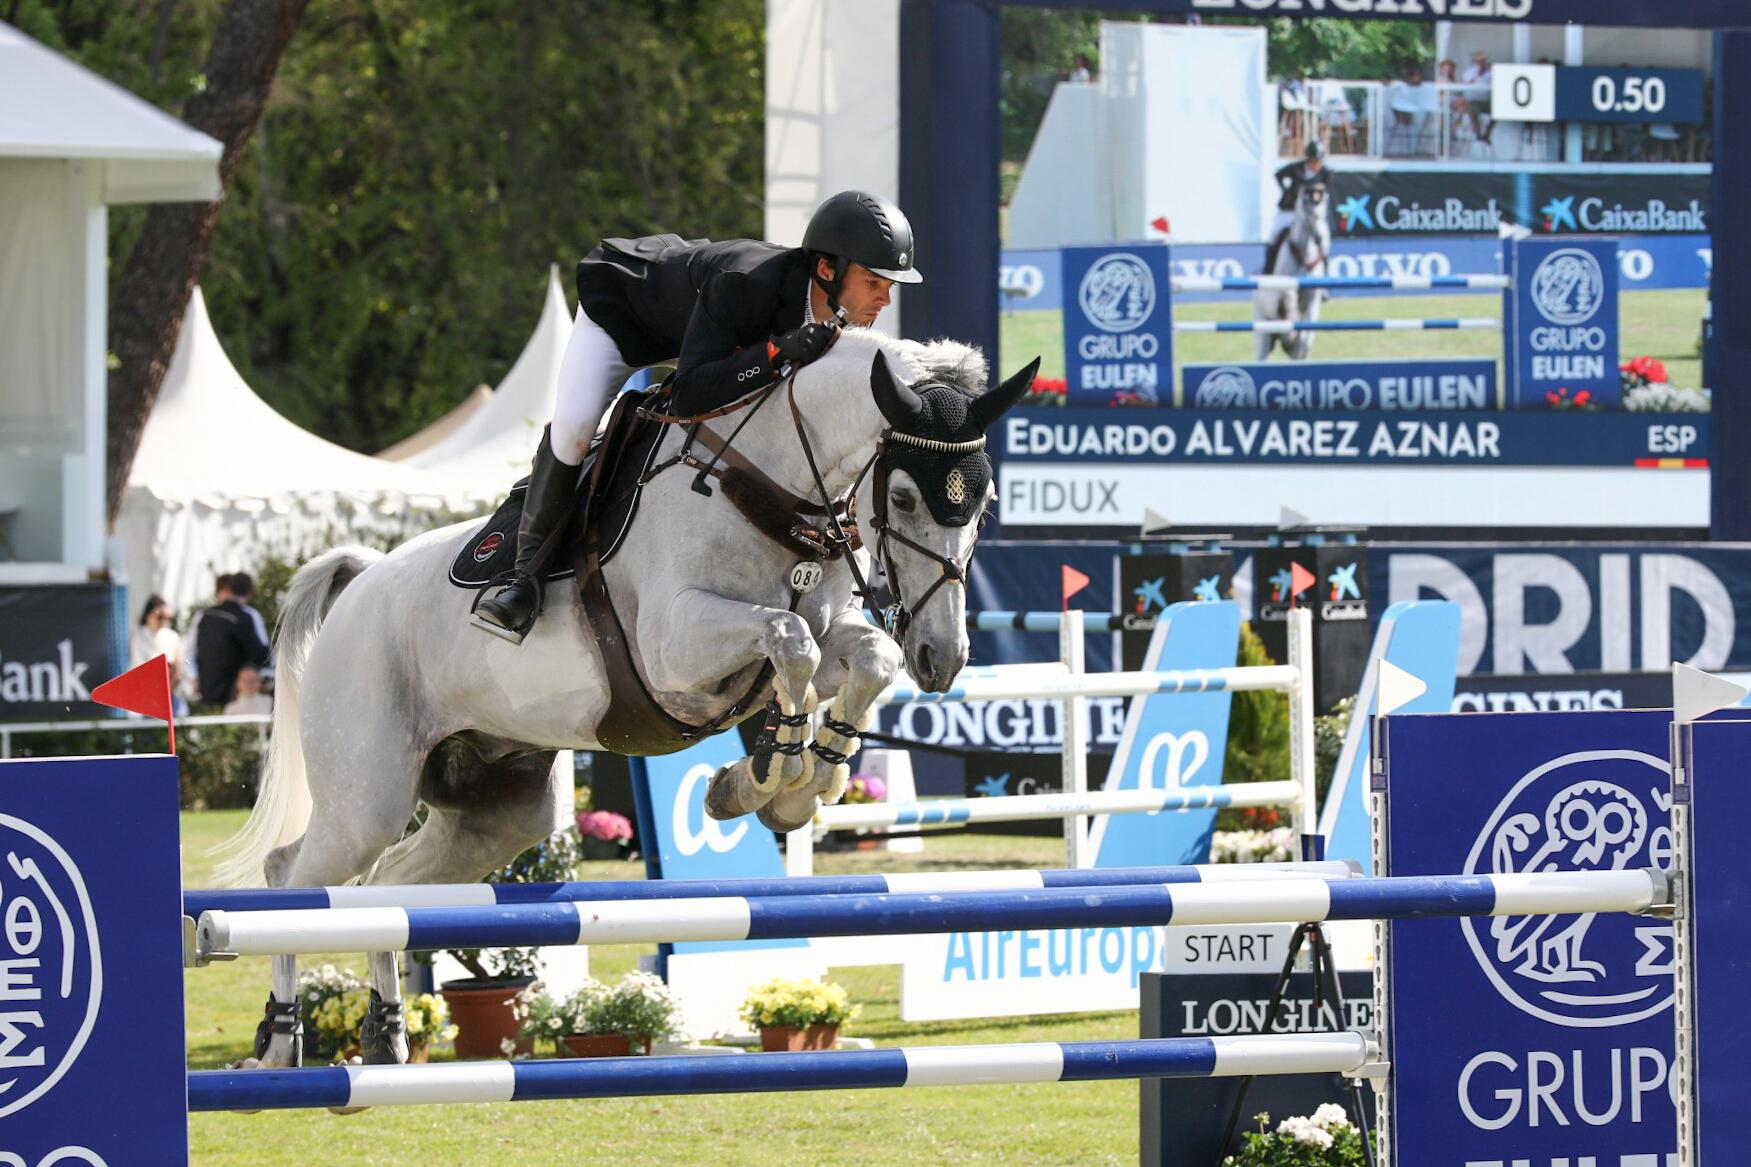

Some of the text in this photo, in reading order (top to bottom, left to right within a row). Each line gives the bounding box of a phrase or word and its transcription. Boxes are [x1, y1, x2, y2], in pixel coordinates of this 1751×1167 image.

[1513, 76, 1532, 108] 0
[1592, 76, 1666, 113] 0.50
[1375, 197, 1502, 231] CaixaBank
[1579, 197, 1707, 232] CaixaBank
[1327, 252, 1451, 278] OLVO
[1078, 333, 1159, 361] GRUPO
[1530, 326, 1606, 352] GRUPO
[1081, 363, 1158, 390] EULEN
[1532, 355, 1604, 380] EULEN
[1259, 374, 1485, 411] GRUPO EULEN
[1006, 418, 1501, 457] EDUARDO ALVAREZ AZNAR
[1648, 424, 1697, 454] ESP
[1008, 480, 1119, 513] FIDUX
[1389, 554, 1735, 673] DRID
[1184, 933, 1275, 963] START
[1181, 998, 1375, 1034] LONGINE
[1458, 1046, 1678, 1130] GRUP
